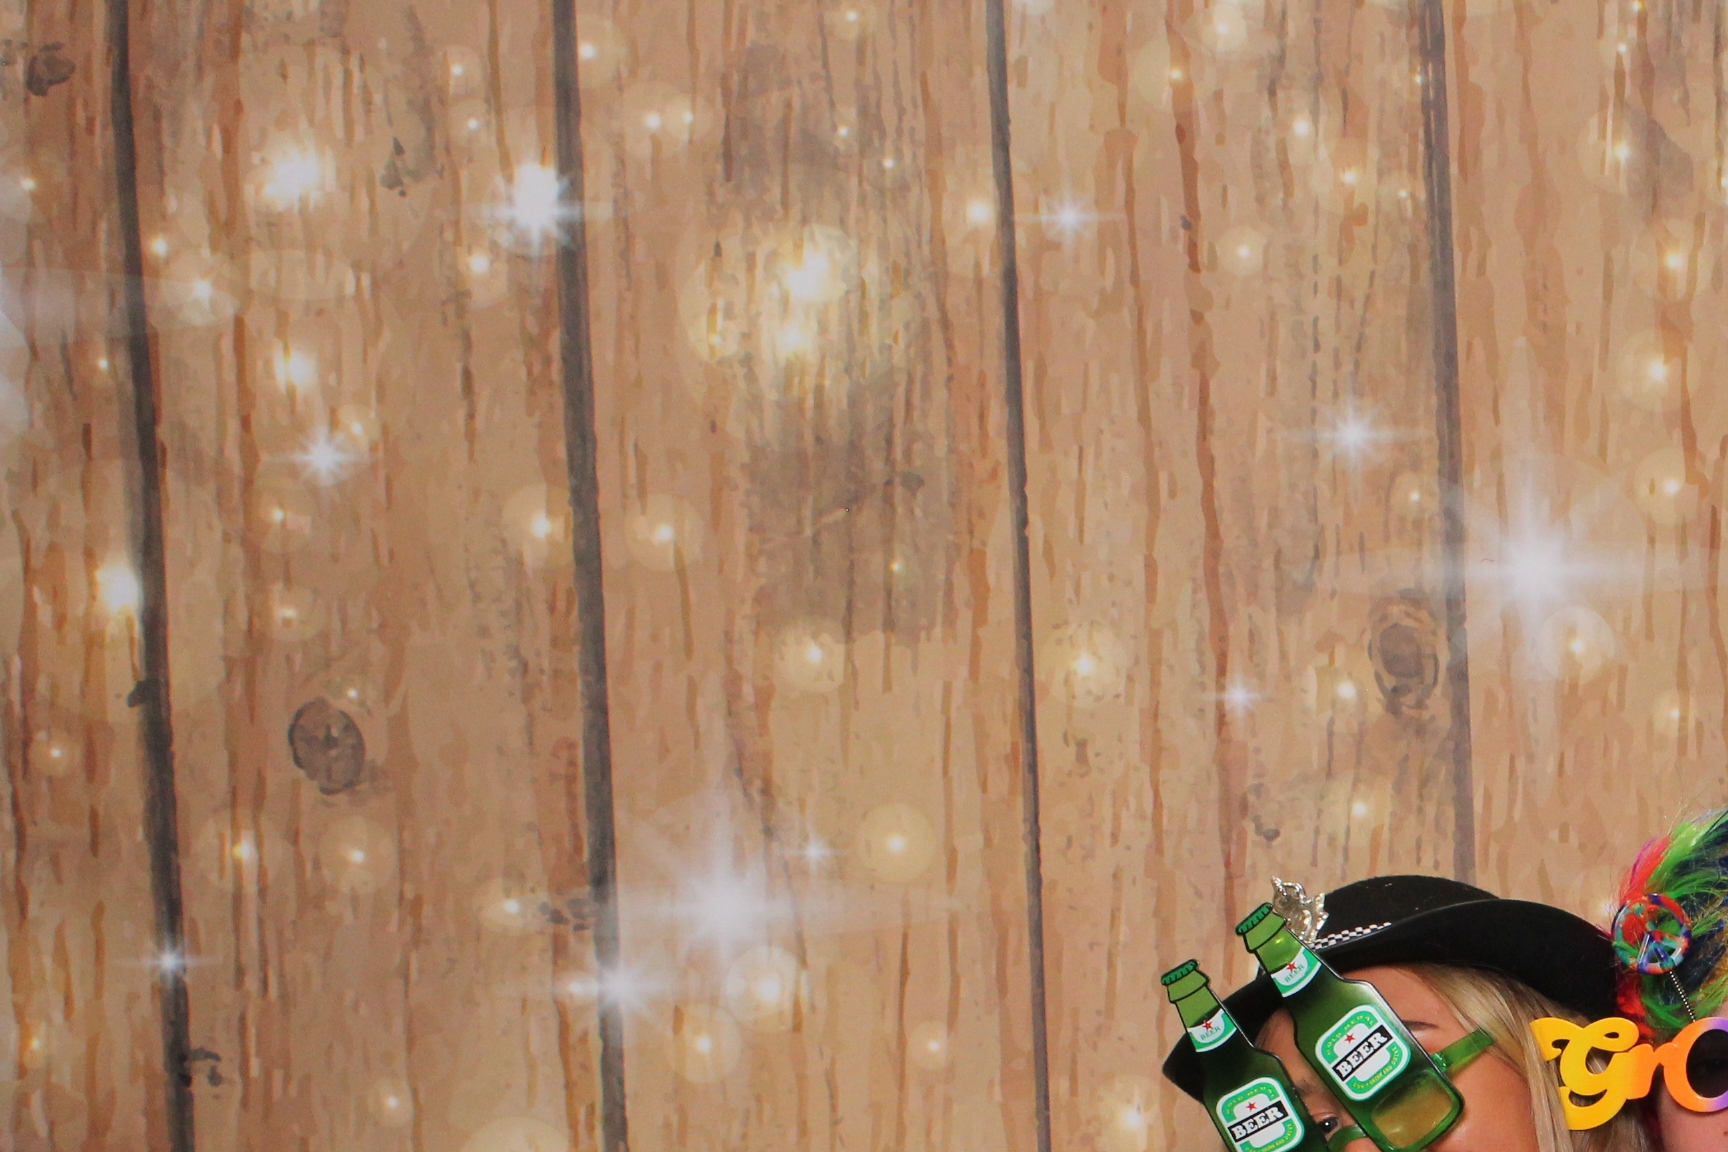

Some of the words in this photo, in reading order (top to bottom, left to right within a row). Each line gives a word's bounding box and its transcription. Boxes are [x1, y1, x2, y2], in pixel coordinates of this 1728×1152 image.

[1200, 1026, 1221, 1040] BEER
[1335, 1032, 1388, 1078] BEER
[1231, 1106, 1284, 1140] BEER
